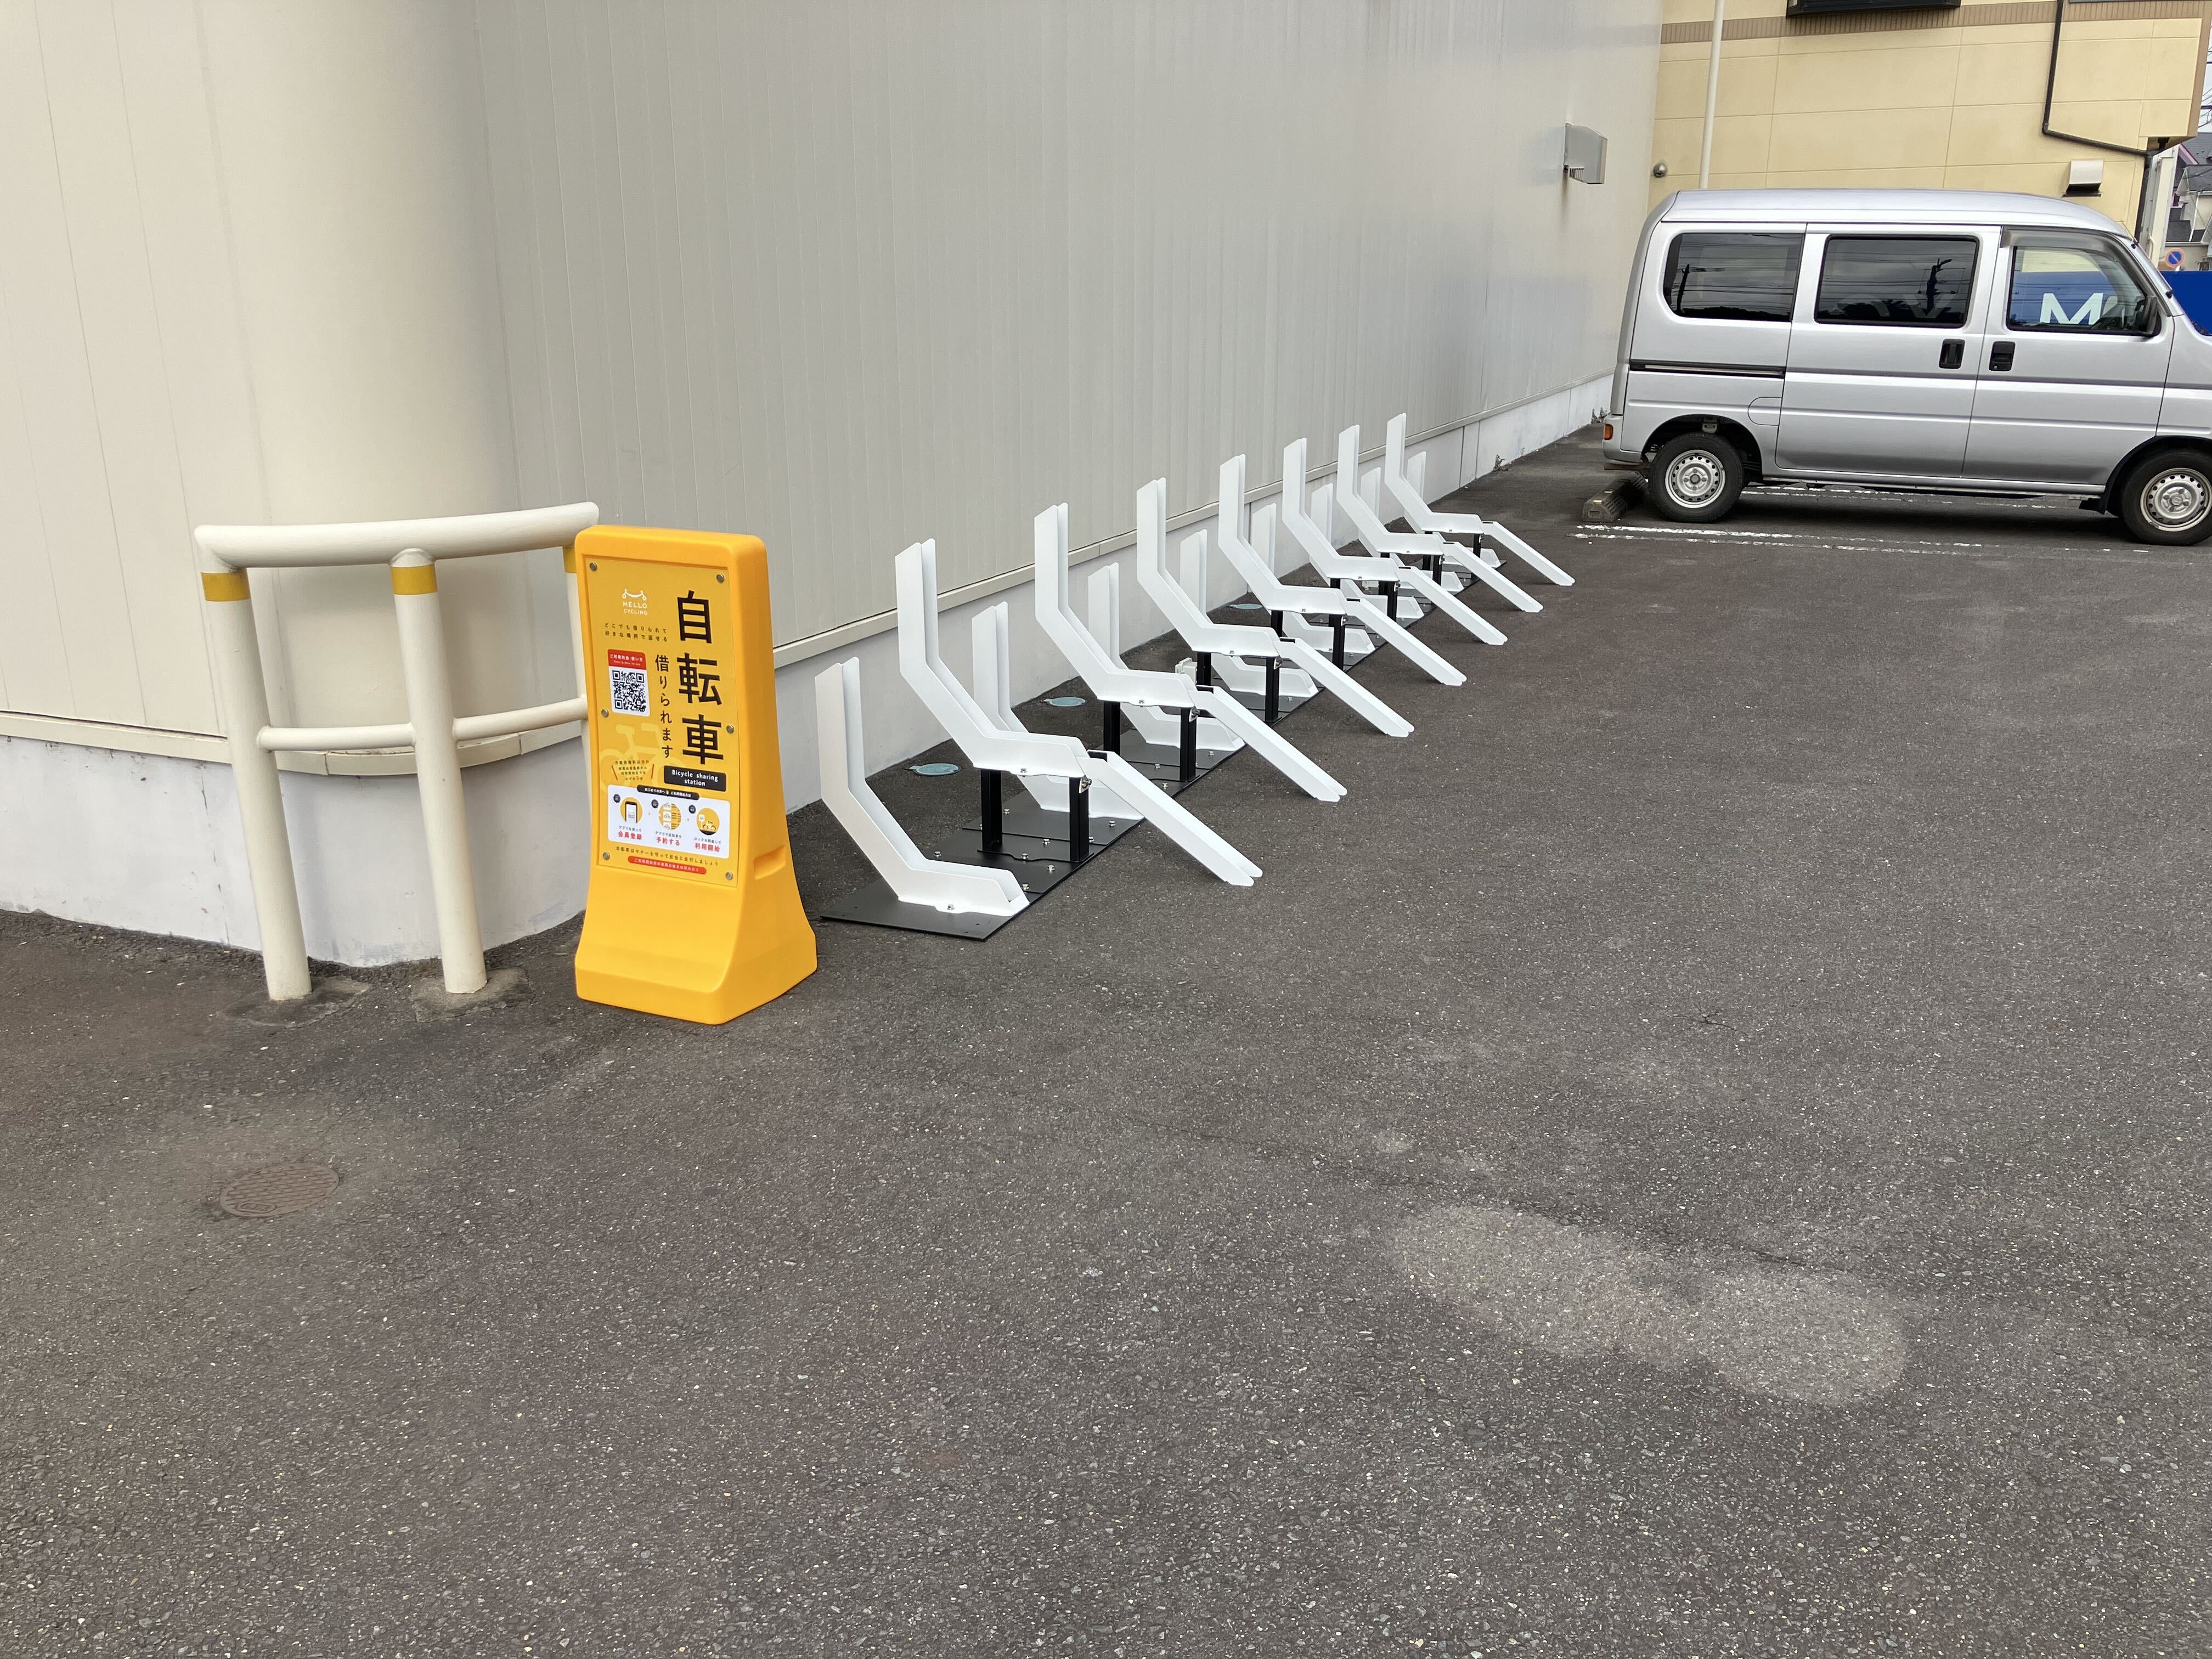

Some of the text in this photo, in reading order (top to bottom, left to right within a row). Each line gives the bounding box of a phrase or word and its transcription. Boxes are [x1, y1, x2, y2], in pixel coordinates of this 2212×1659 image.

[623, 601, 647, 609] HELLO
[677, 590, 724, 764] 自転車
[655, 654, 673, 758] 借りられます
[672, 769, 719, 783] Bicycle sharing
[684, 778, 706, 787] station
[618, 831, 642, 840] 会員登録
[656, 836, 680, 846] 予約する
[695, 843, 720, 852] 利用開始
